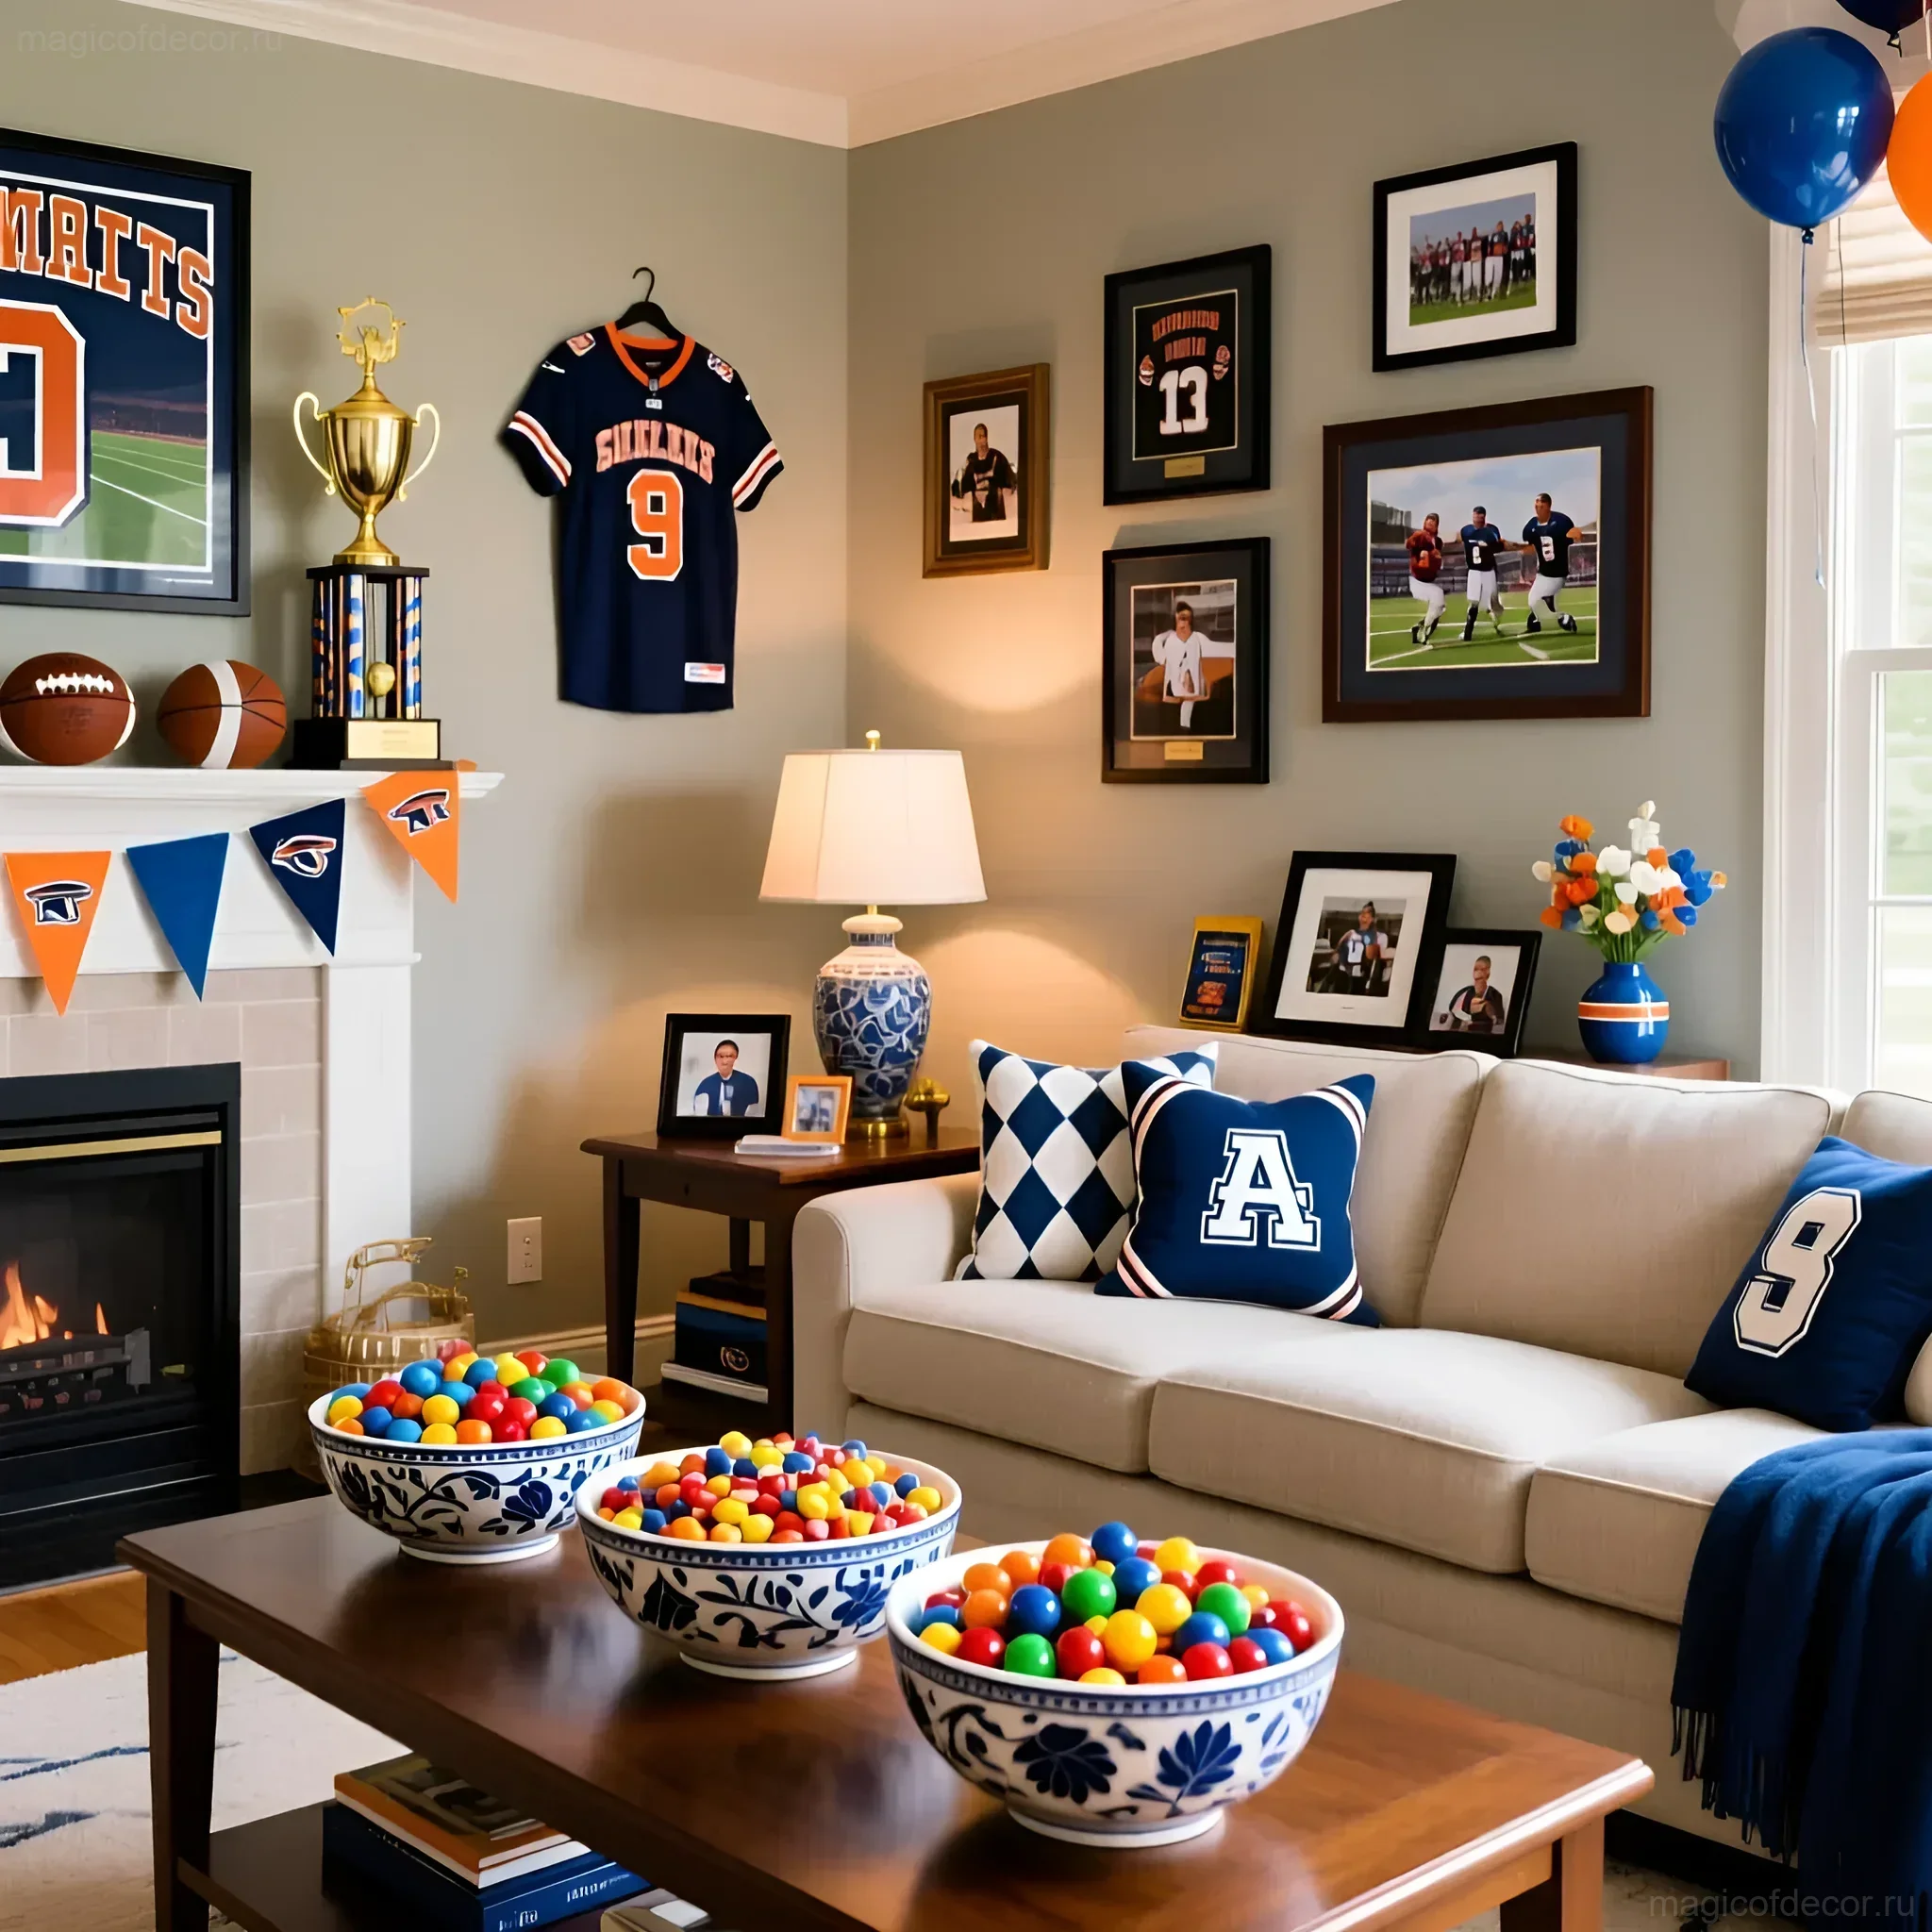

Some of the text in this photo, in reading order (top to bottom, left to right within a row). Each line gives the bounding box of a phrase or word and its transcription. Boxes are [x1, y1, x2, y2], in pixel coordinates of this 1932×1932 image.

[626, 469, 683, 581] 9
[1200, 1127, 1322, 1252] A
[1733, 1186, 1862, 1358] 9
